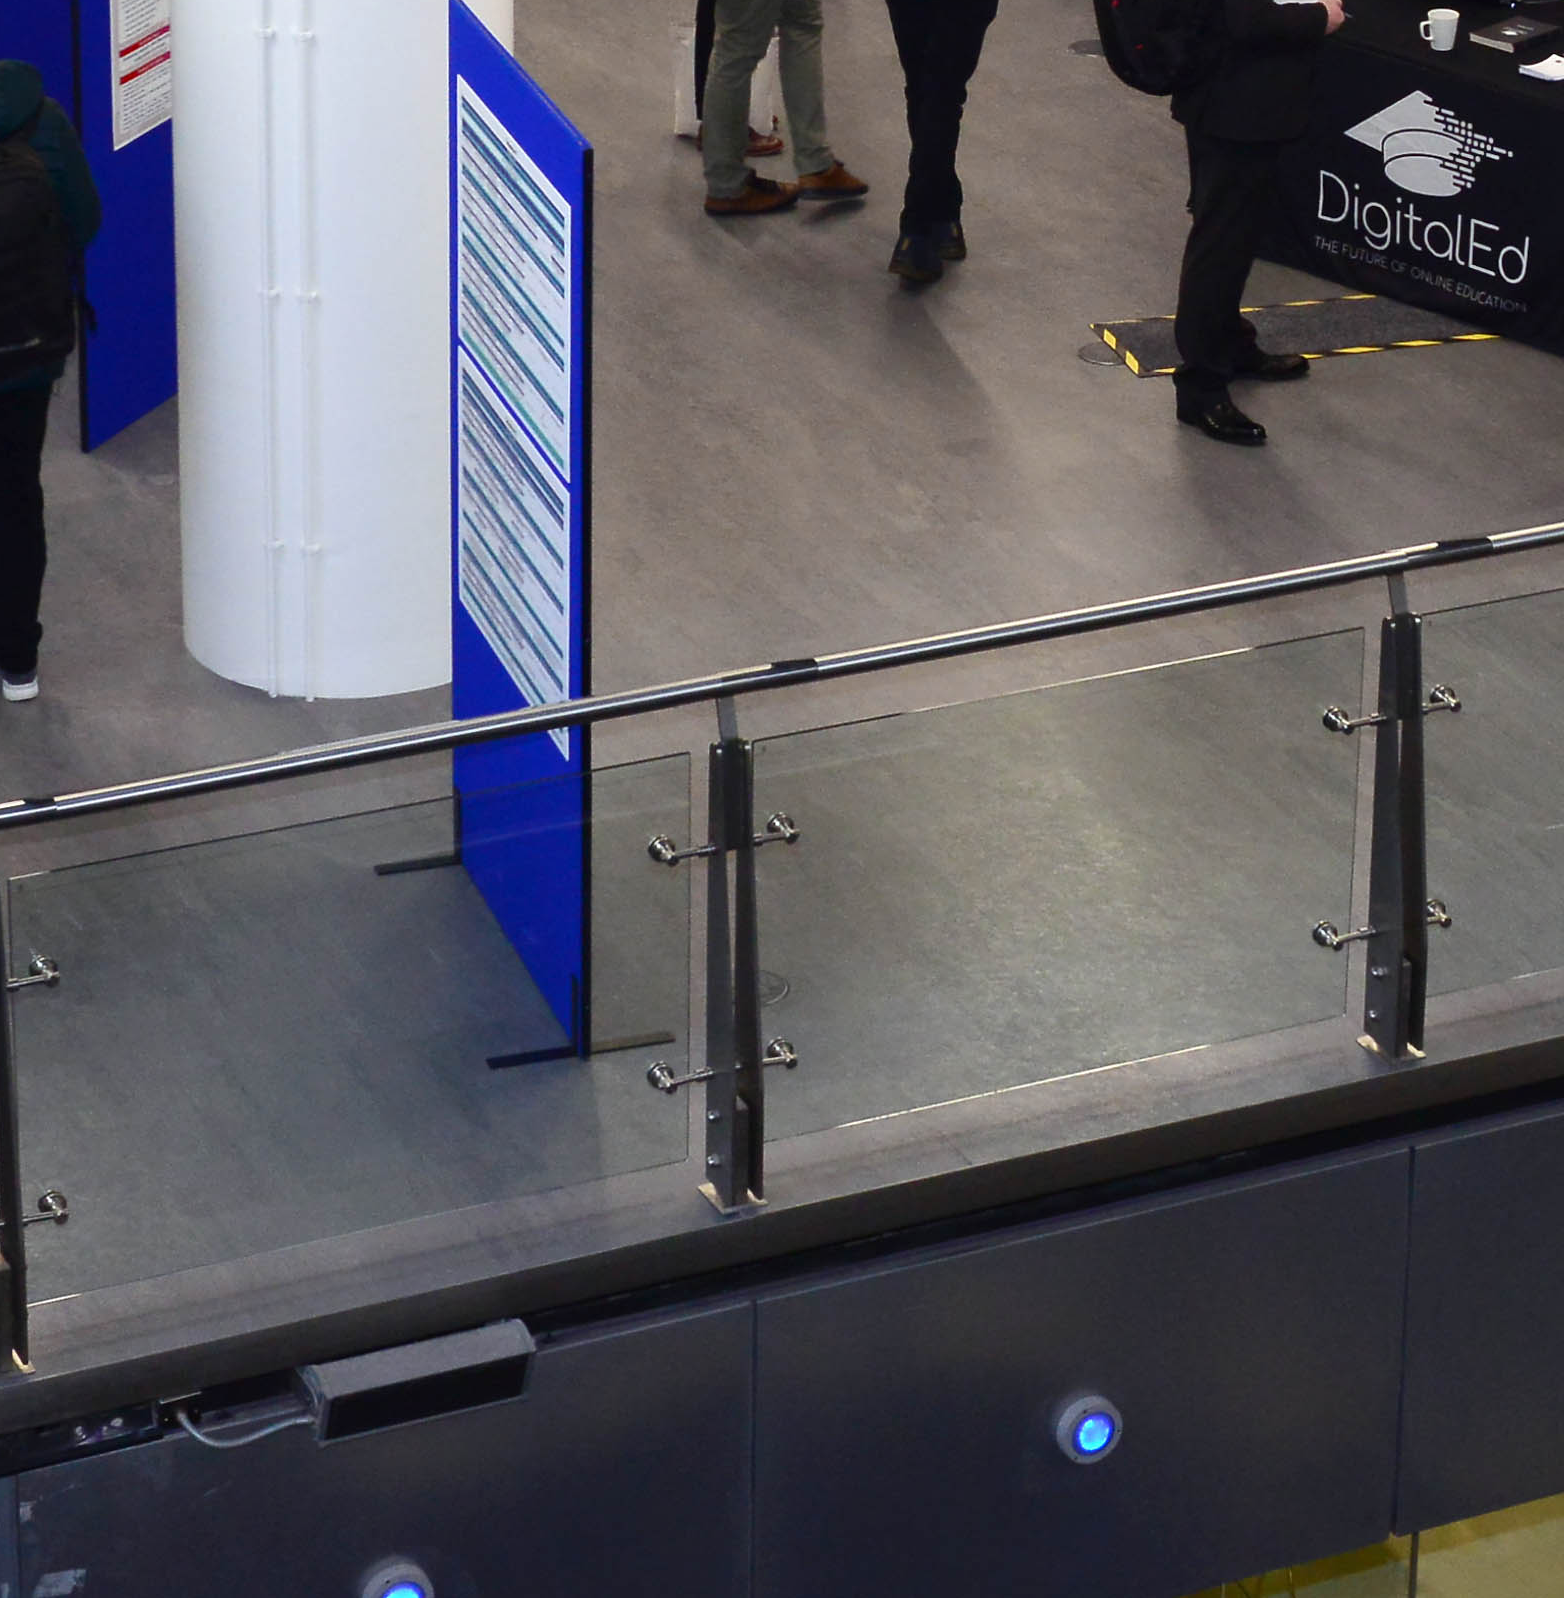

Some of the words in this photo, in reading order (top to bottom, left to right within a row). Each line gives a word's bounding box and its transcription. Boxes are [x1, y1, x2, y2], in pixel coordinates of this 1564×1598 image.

[1313, 235, 1340, 253] THE
[1341, 243, 1389, 270] FUTURE
[1390, 258, 1409, 273] OF
[1409, 265, 1454, 294] ONLINE
[1454, 281, 1528, 314] EDUCATION
[1317, 169, 1530, 284] DigitalEd
